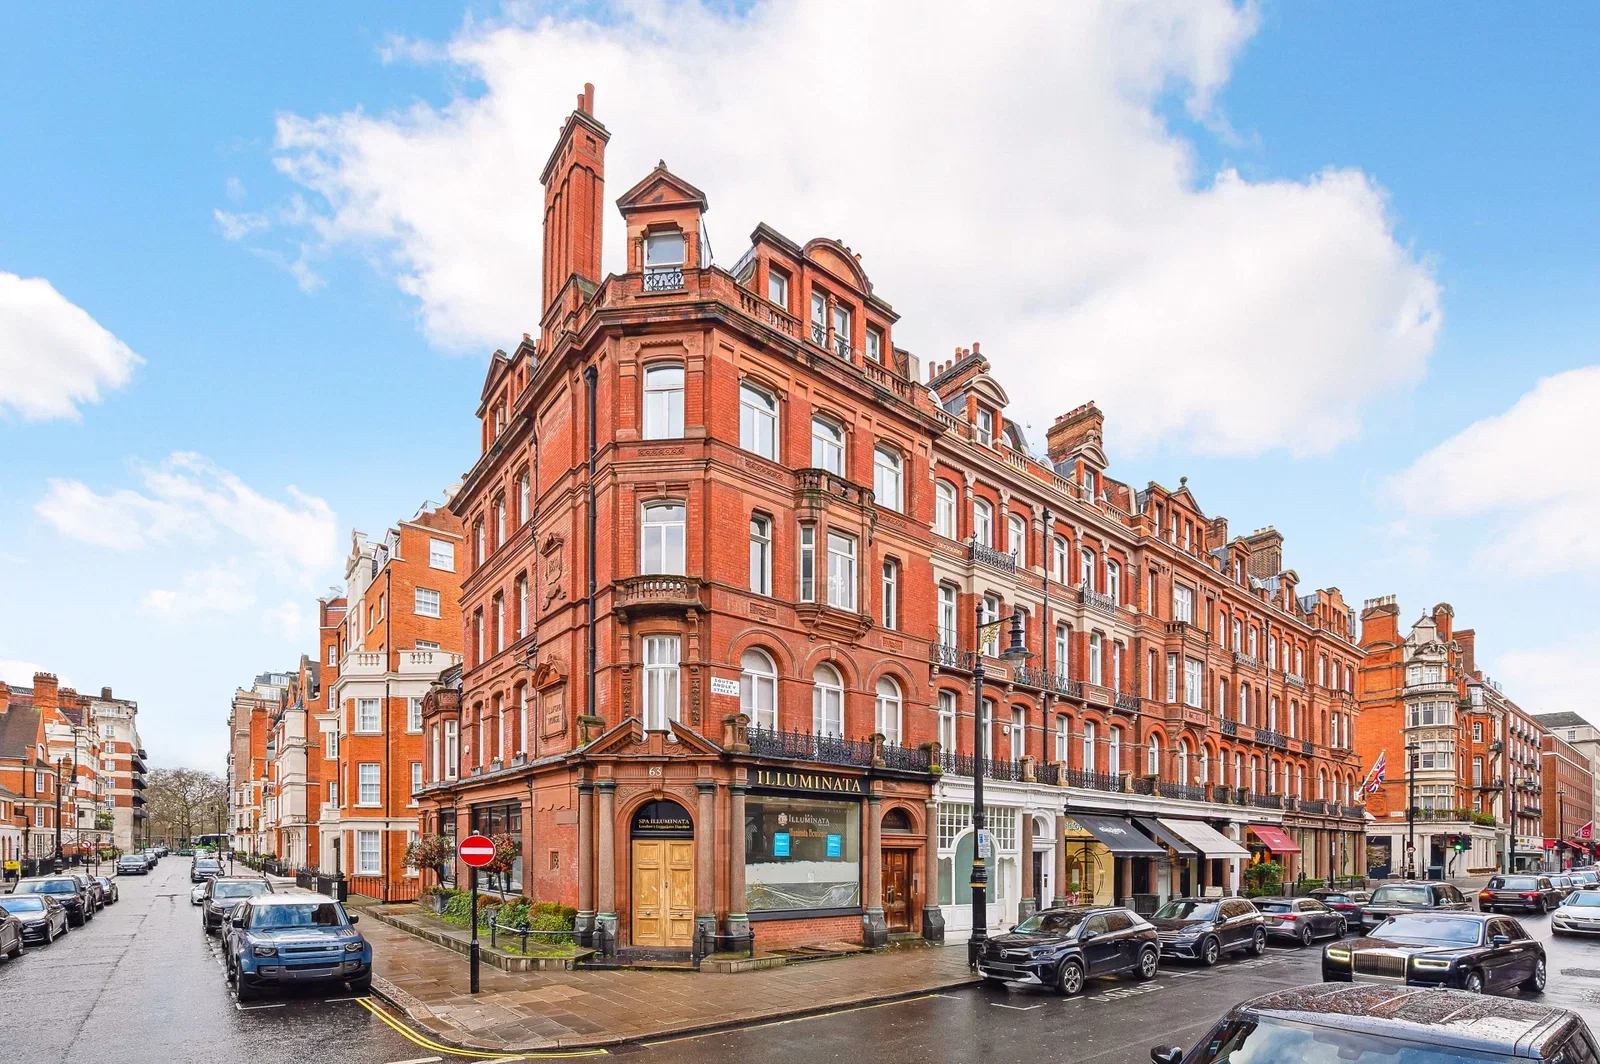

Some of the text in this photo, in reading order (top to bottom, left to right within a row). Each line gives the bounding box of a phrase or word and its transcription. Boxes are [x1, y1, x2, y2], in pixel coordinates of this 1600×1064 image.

[713, 682, 736, 690] AUDLEY
[648, 766, 662, 776] 63
[757, 770, 861, 792] ILLUMINATA
